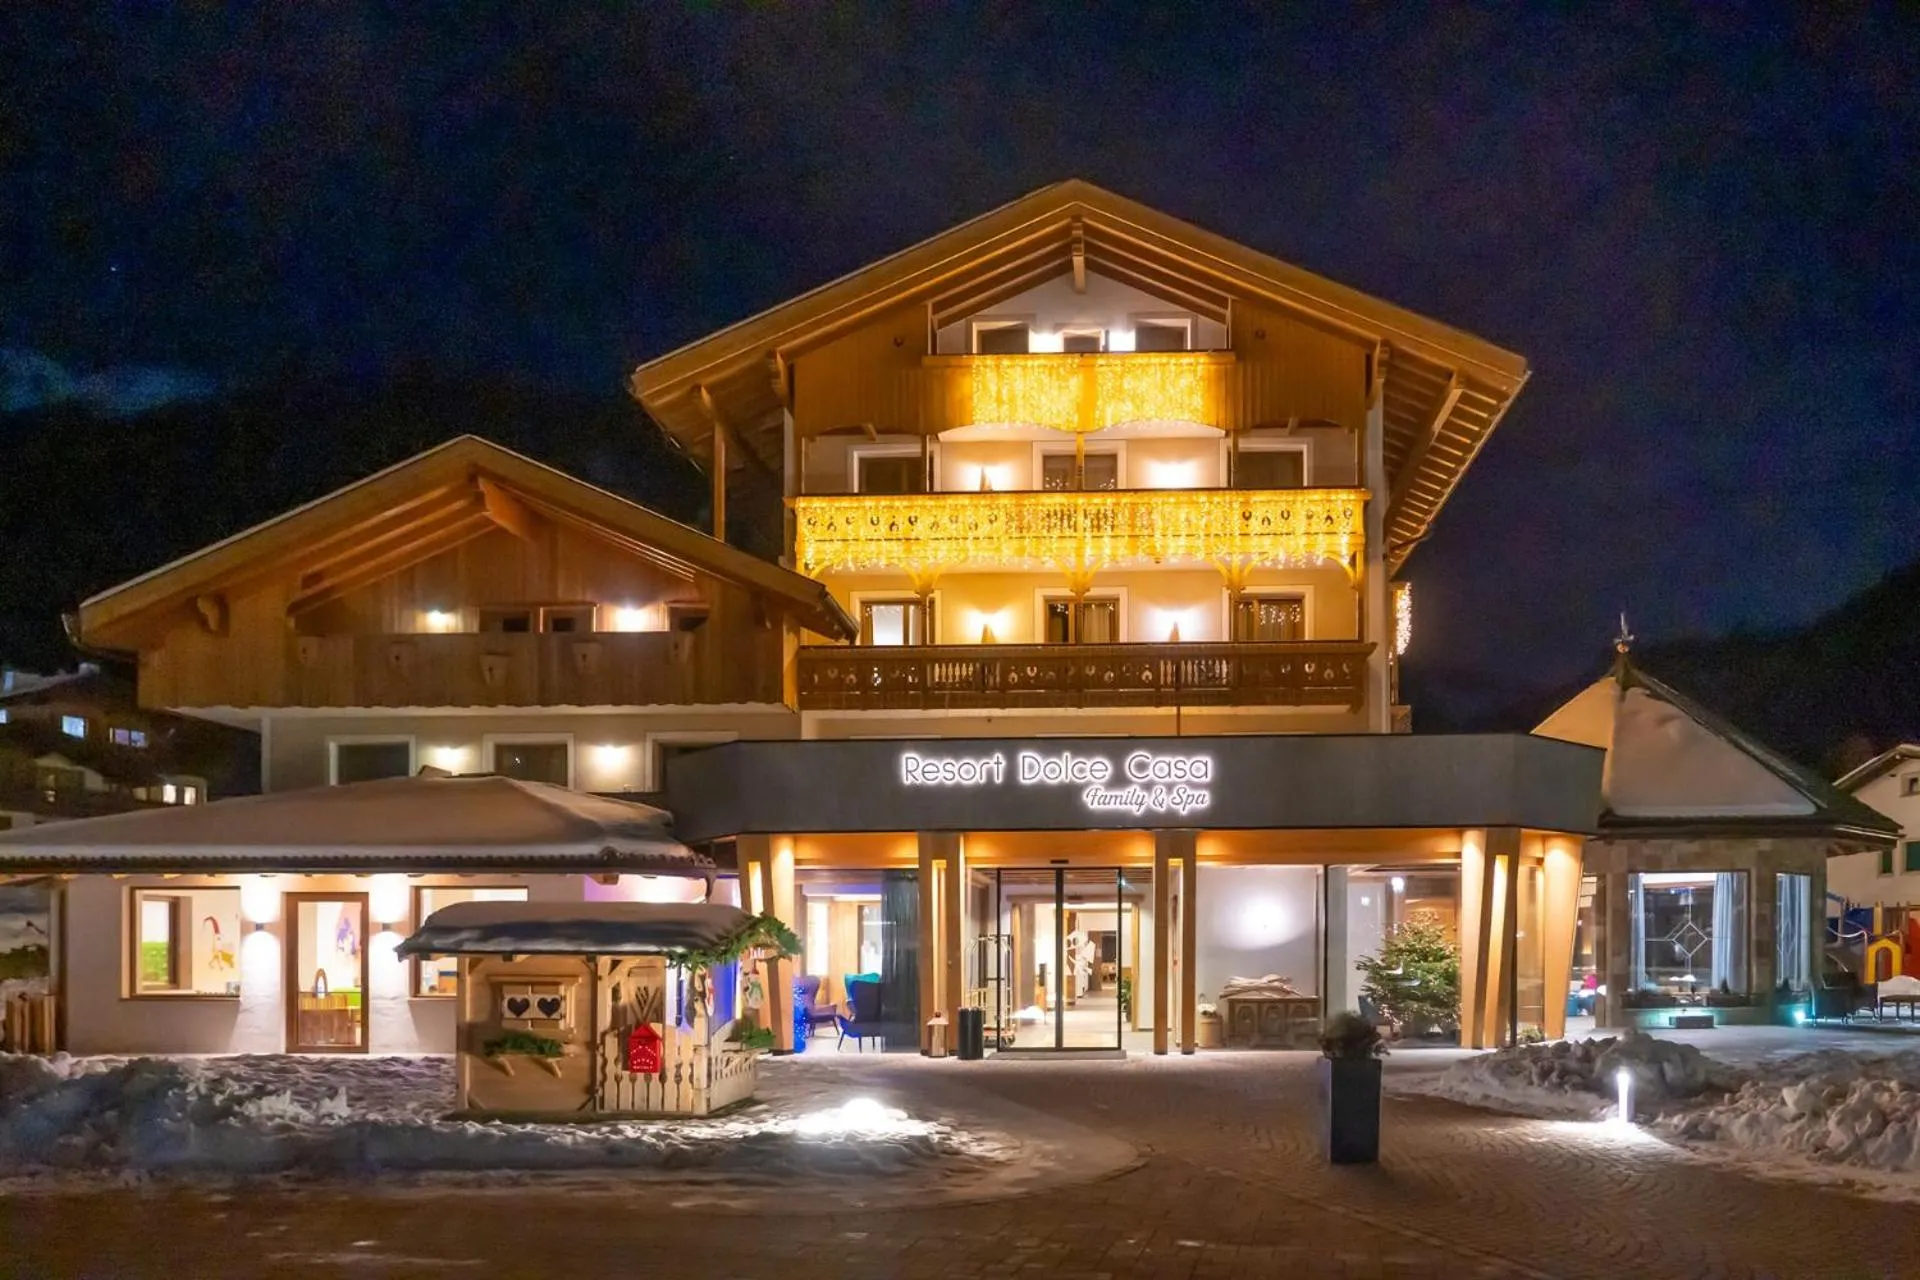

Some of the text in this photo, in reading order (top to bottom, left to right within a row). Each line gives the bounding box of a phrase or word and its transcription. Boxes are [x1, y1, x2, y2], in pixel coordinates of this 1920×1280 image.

[903, 752, 1210, 783] Resort Dolce Casa
[1085, 786, 1208, 814] Family & Spa
